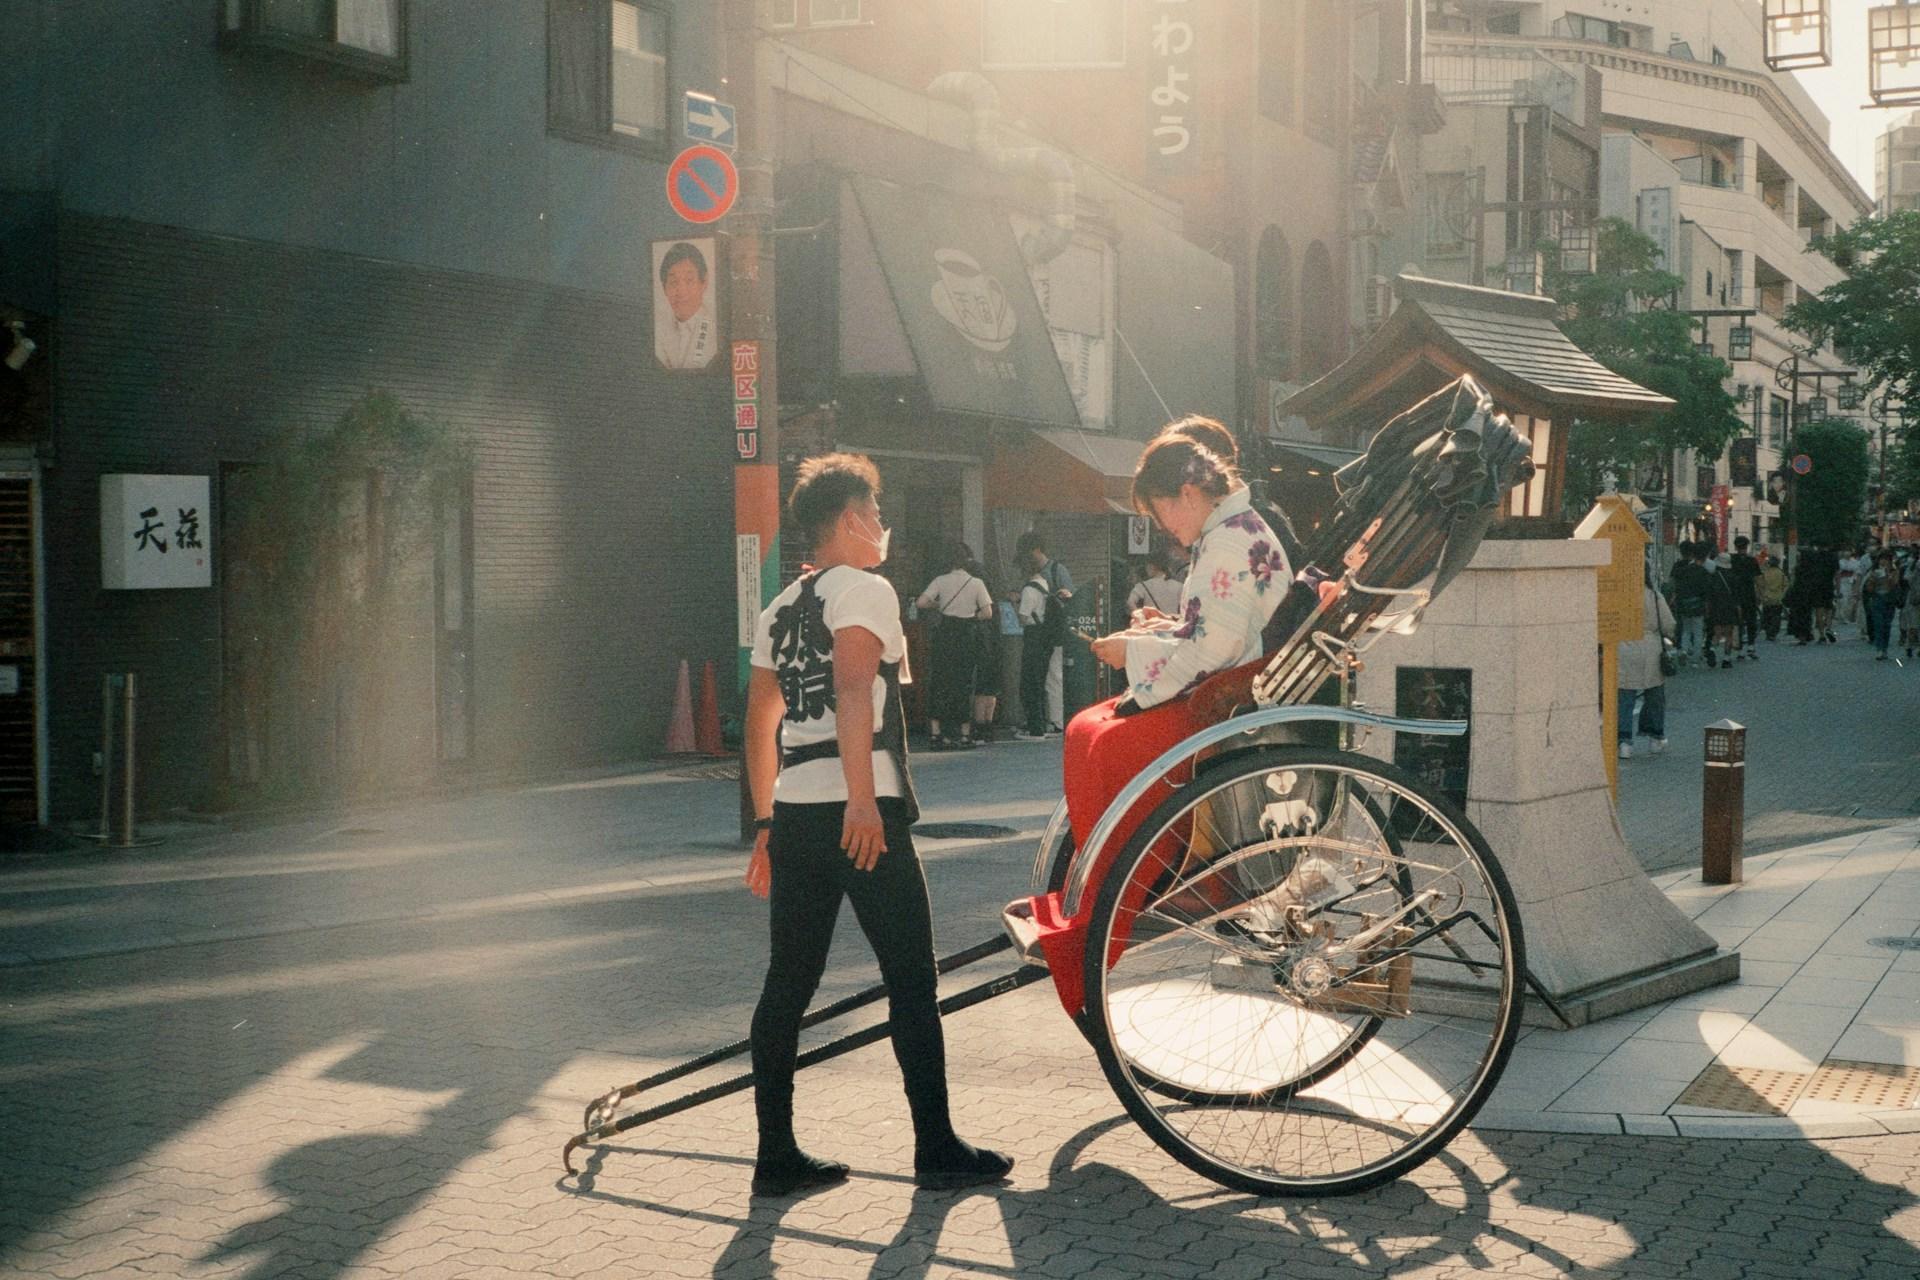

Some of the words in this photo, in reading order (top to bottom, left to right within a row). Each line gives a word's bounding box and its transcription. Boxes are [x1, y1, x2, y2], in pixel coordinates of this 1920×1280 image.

[1151, 0, 1193, 155] わよう
[734, 344, 759, 459] 六区通り
